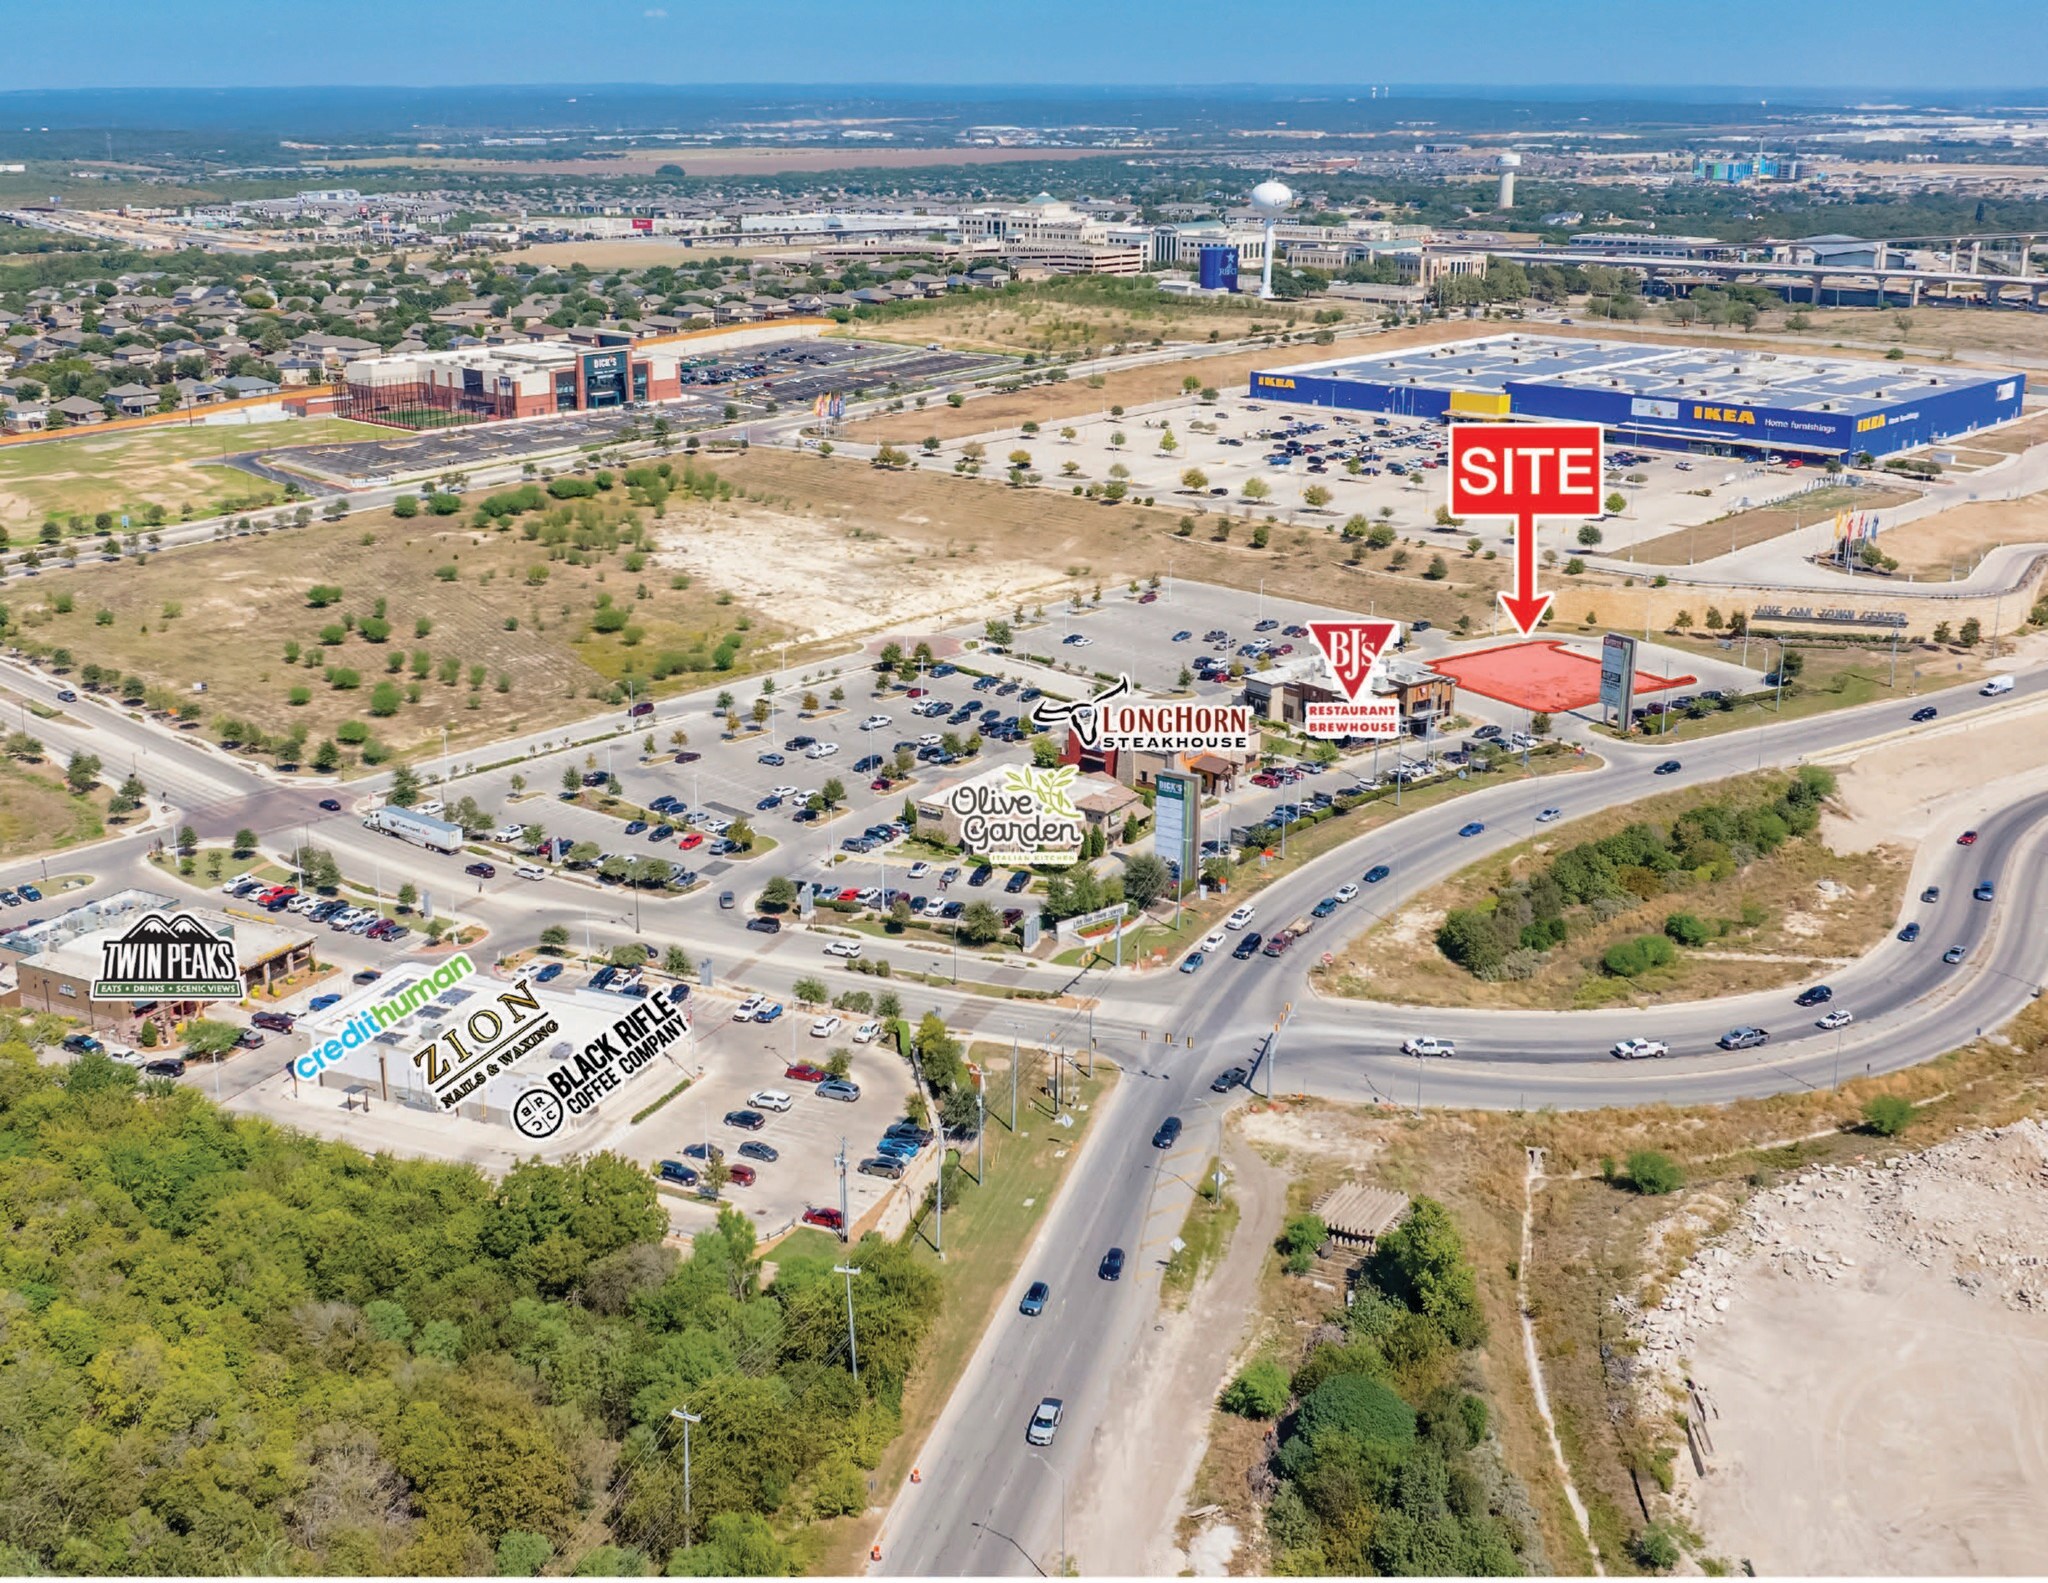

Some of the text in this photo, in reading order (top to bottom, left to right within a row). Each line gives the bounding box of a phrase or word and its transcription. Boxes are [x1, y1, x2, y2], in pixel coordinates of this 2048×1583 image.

[1258, 376, 1296, 389] IKEA
[1693, 406, 1756, 425] IKEA
[1857, 413, 1886, 433] IKEA
[1764, 418, 1836, 434] Home furnishings
